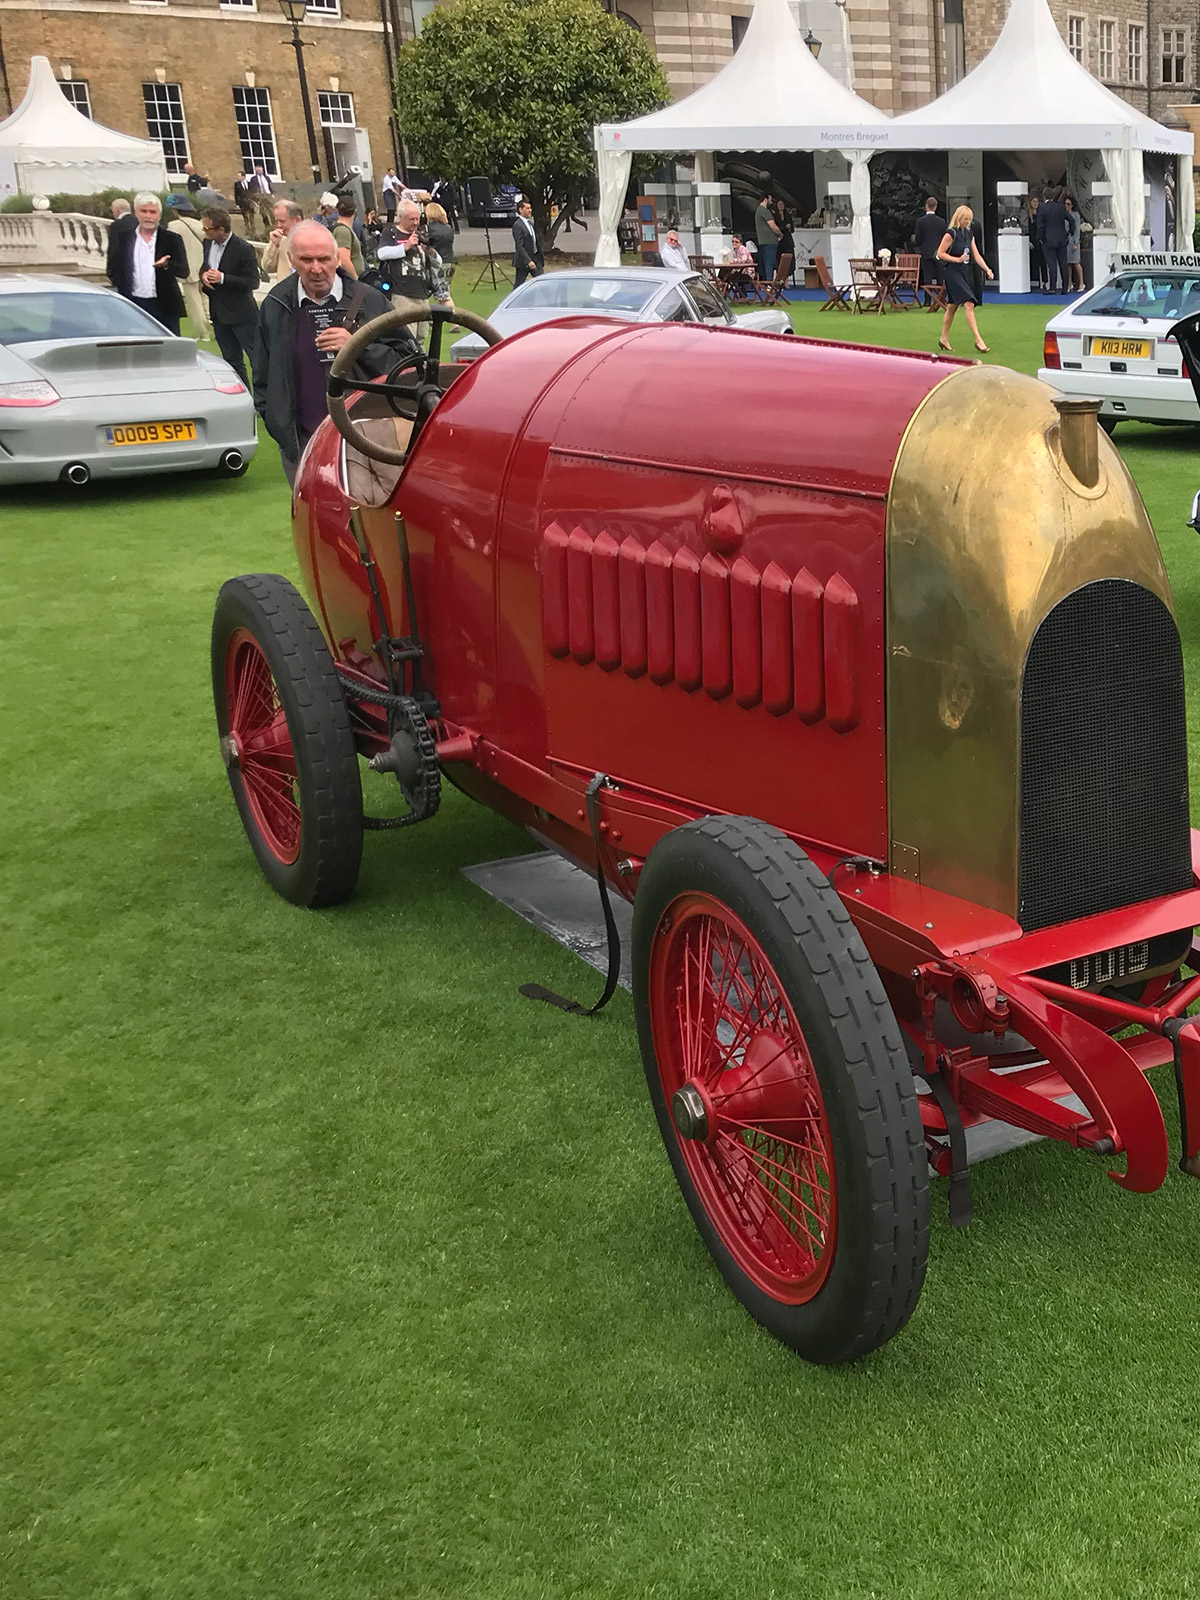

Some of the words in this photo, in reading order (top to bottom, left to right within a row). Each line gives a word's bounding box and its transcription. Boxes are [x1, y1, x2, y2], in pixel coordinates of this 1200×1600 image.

[820, 131, 855, 141] Montres
[856, 131, 889, 143] Breguet
[1121, 254, 1167, 266] MARTINI
[162, 423, 193, 440] SPT
